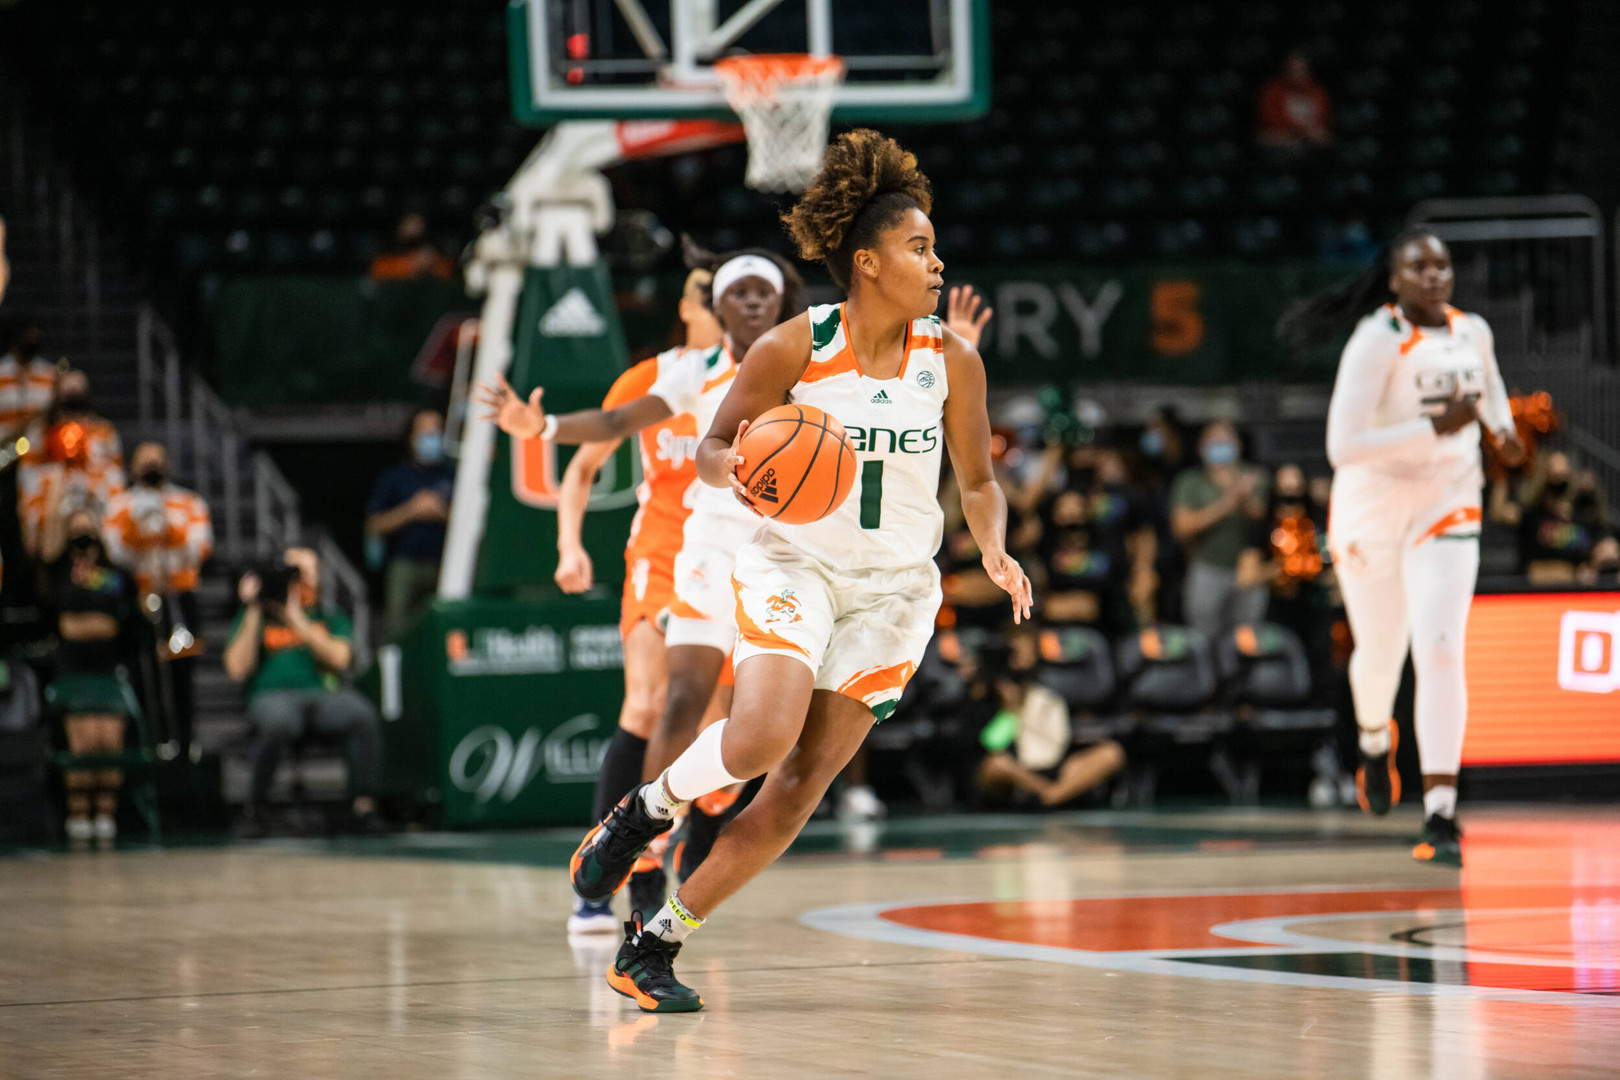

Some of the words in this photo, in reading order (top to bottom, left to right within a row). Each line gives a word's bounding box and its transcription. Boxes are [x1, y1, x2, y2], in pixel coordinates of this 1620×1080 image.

[980, 279, 1124, 358] RY
[1151, 280, 1205, 355] 5
[750, 467, 776, 497] adidas
[859, 460, 884, 530] 1
